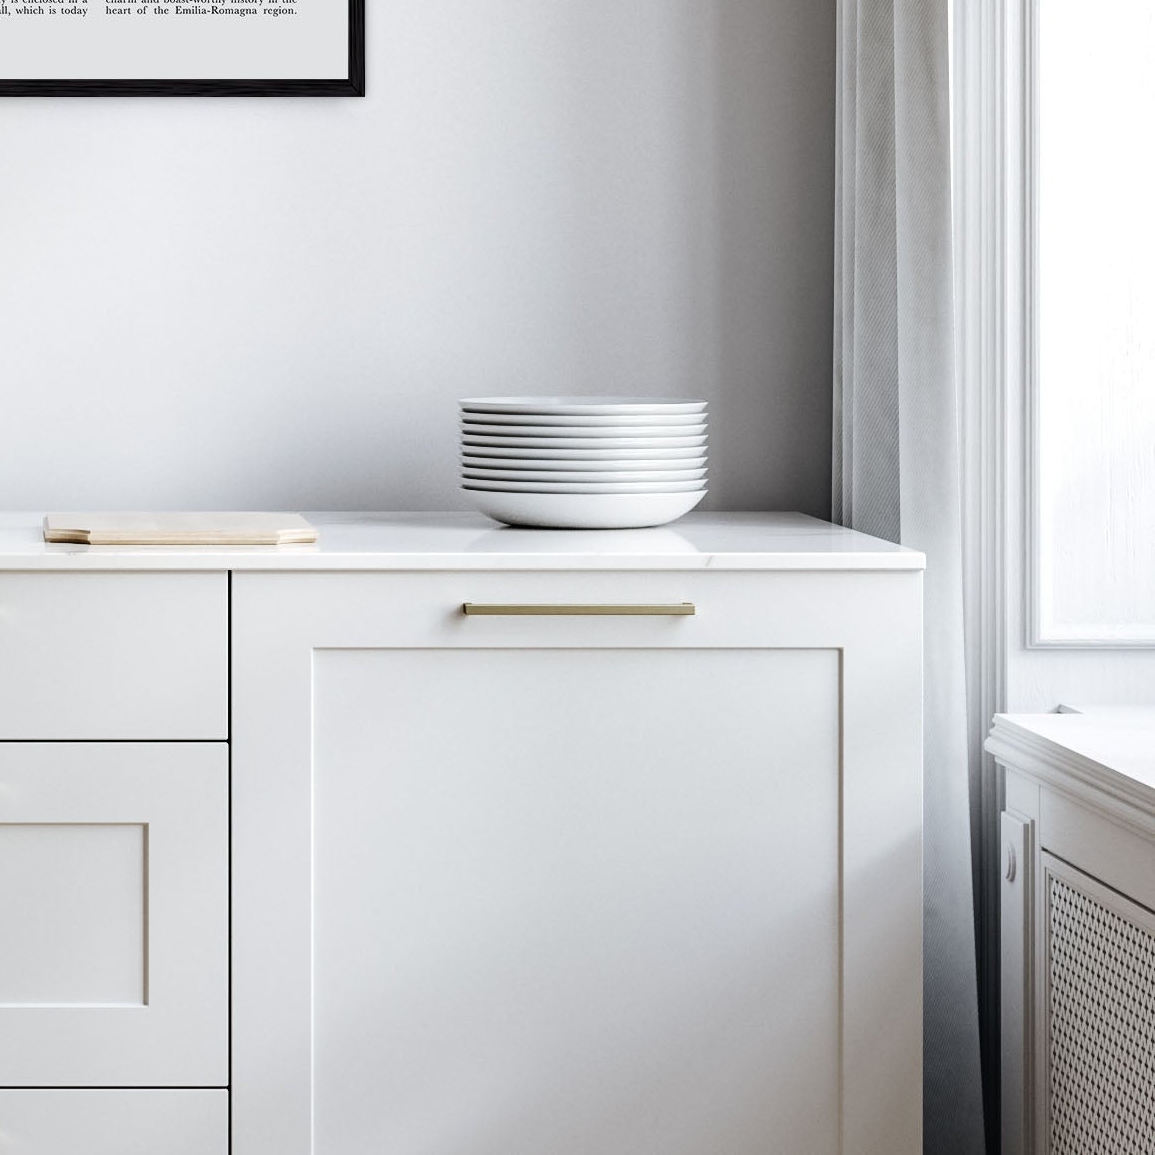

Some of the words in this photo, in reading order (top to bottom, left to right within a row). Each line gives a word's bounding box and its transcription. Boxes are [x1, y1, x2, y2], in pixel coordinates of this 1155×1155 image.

[105, 6, 132, 15] heart
[136, 6, 149, 15] of
[153, 6, 170, 15] the
[175, 6, 258, 17] Emilia-Romagna
[263, 6, 297, 17] region.
